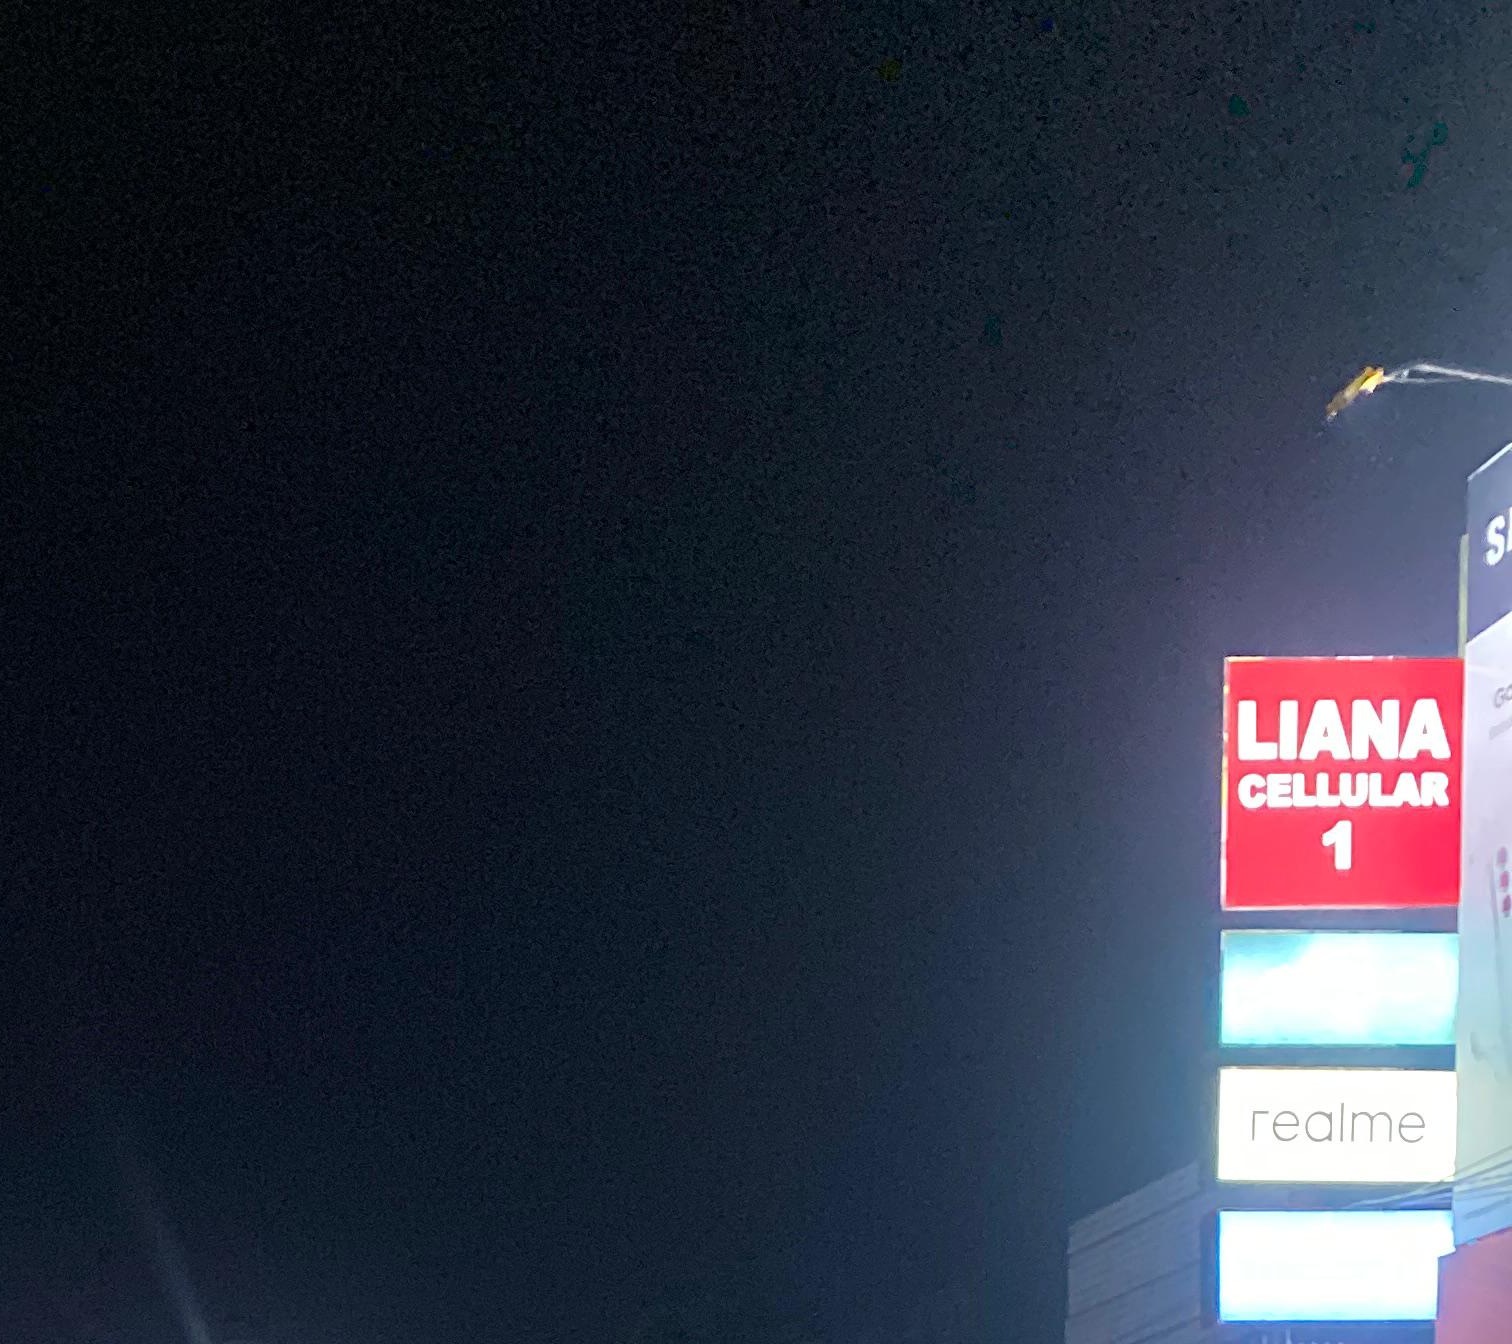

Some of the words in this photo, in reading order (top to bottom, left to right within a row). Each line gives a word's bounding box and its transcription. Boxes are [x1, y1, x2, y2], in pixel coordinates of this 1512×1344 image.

[1484, 506, 1512, 566] S
[1238, 698, 1451, 761] LIANA
[1238, 772, 1450, 809] CELLULAR
[1321, 820, 1352, 870] 1
[1251, 1102, 1426, 1143] realme
